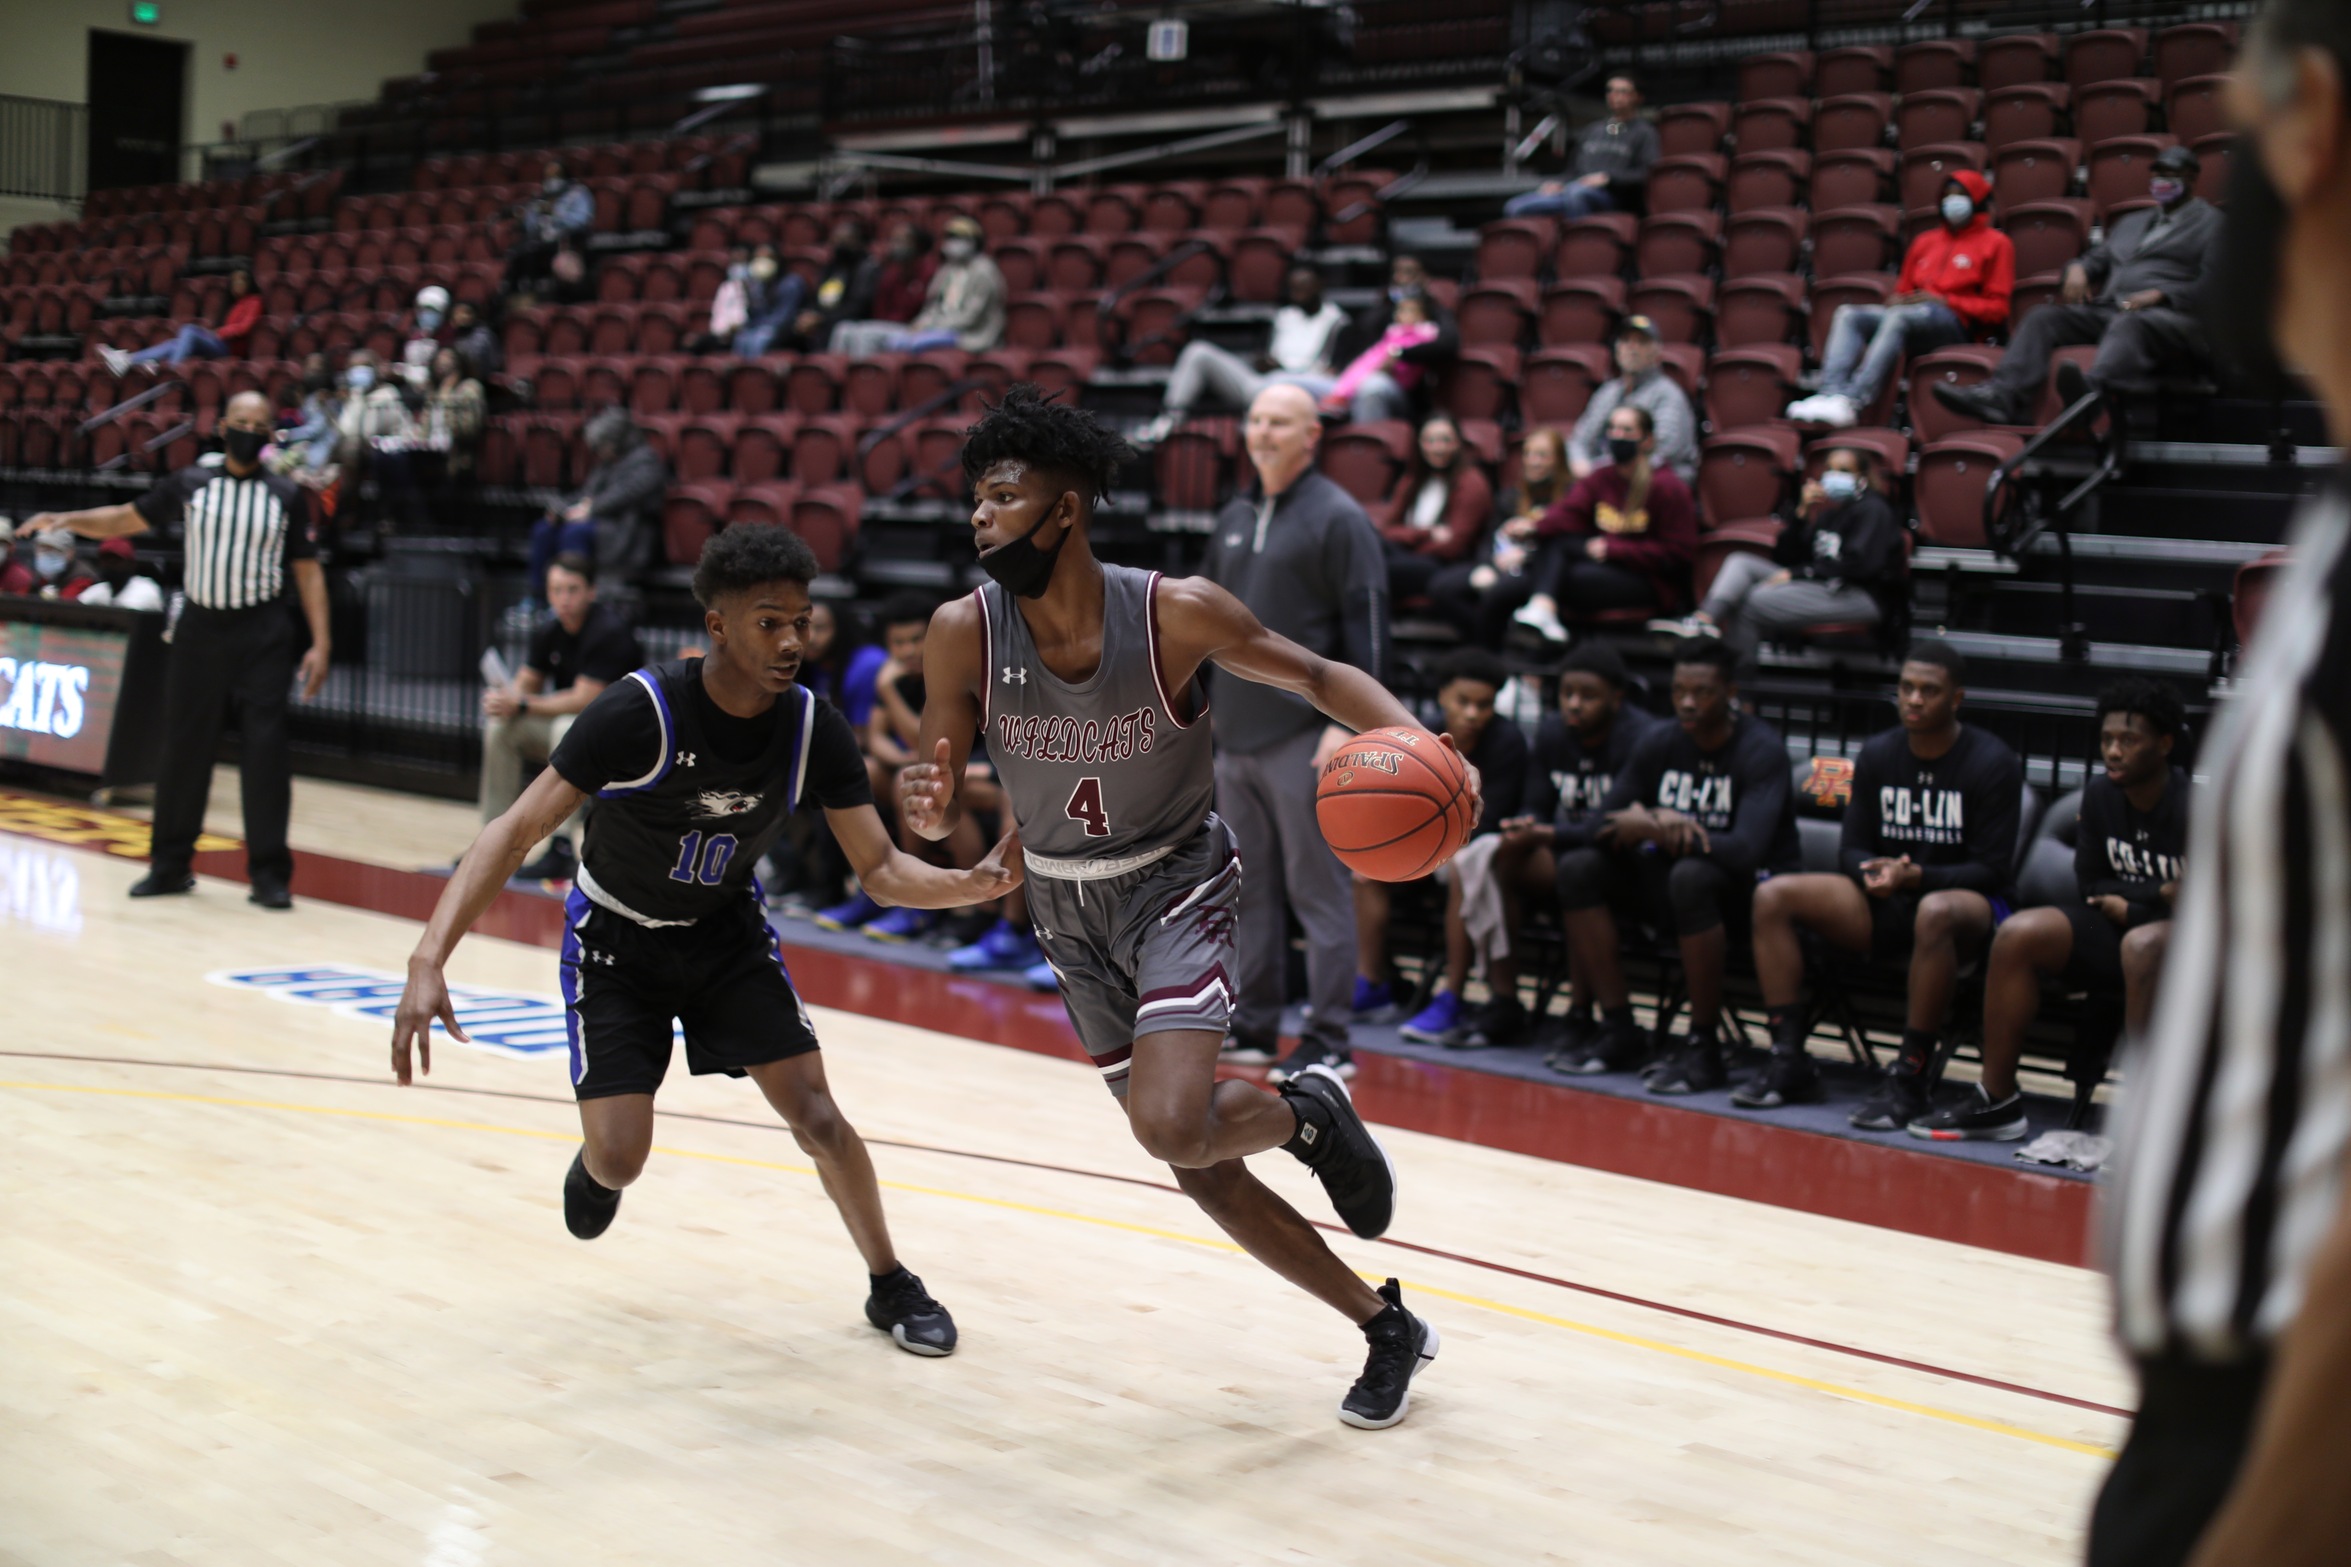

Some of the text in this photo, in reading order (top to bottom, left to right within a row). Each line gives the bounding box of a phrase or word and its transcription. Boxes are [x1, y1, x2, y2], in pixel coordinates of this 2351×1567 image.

[998, 706, 1155, 763] WILDCATS
[1319, 751, 1405, 778] SPALDIN
[1065, 777, 1111, 837] 4
[1880, 785, 1963, 829] CO-LIN
[669, 829, 739, 885] 10
